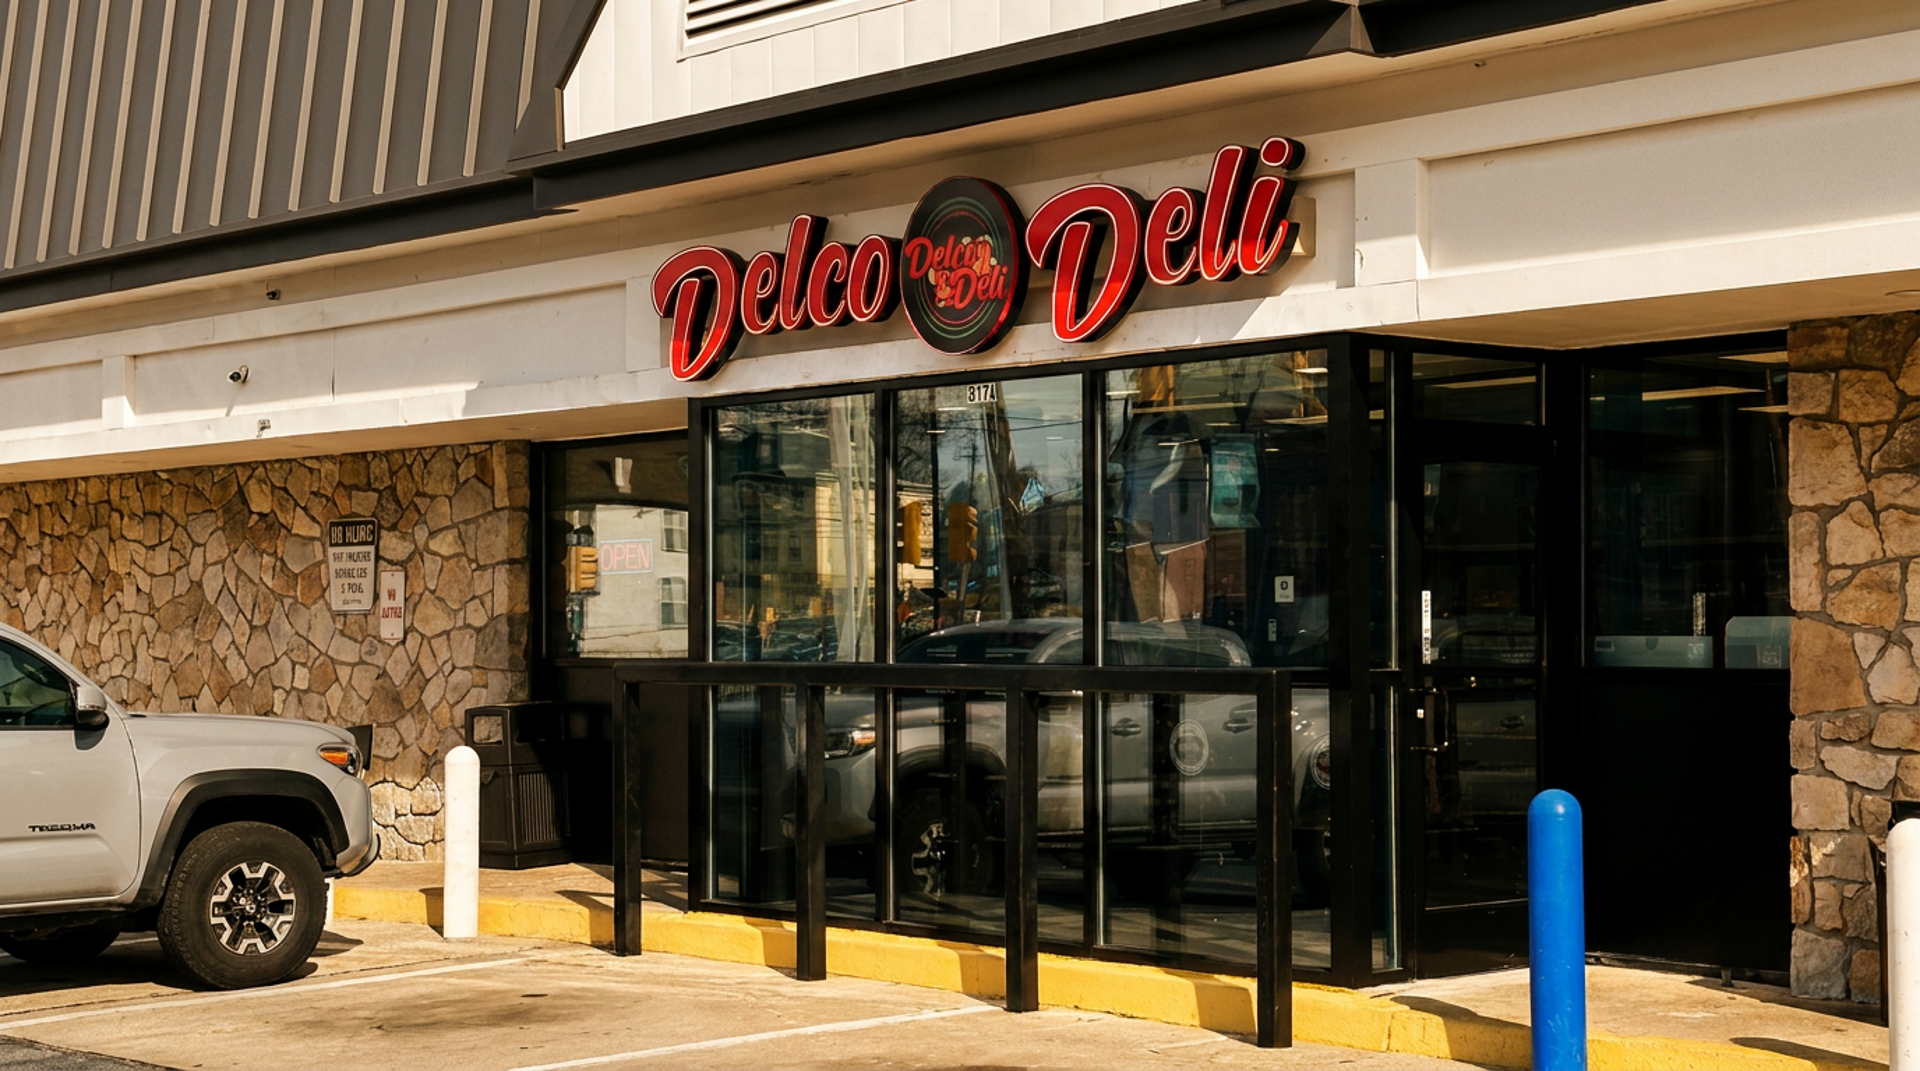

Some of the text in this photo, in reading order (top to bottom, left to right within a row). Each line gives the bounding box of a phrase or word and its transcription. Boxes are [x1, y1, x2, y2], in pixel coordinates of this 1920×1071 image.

[651, 136, 1292, 382] Delco Deli
[904, 234, 976, 280] Delco
[950, 264, 1010, 311] Deli
[601, 542, 650, 571] OPEN
